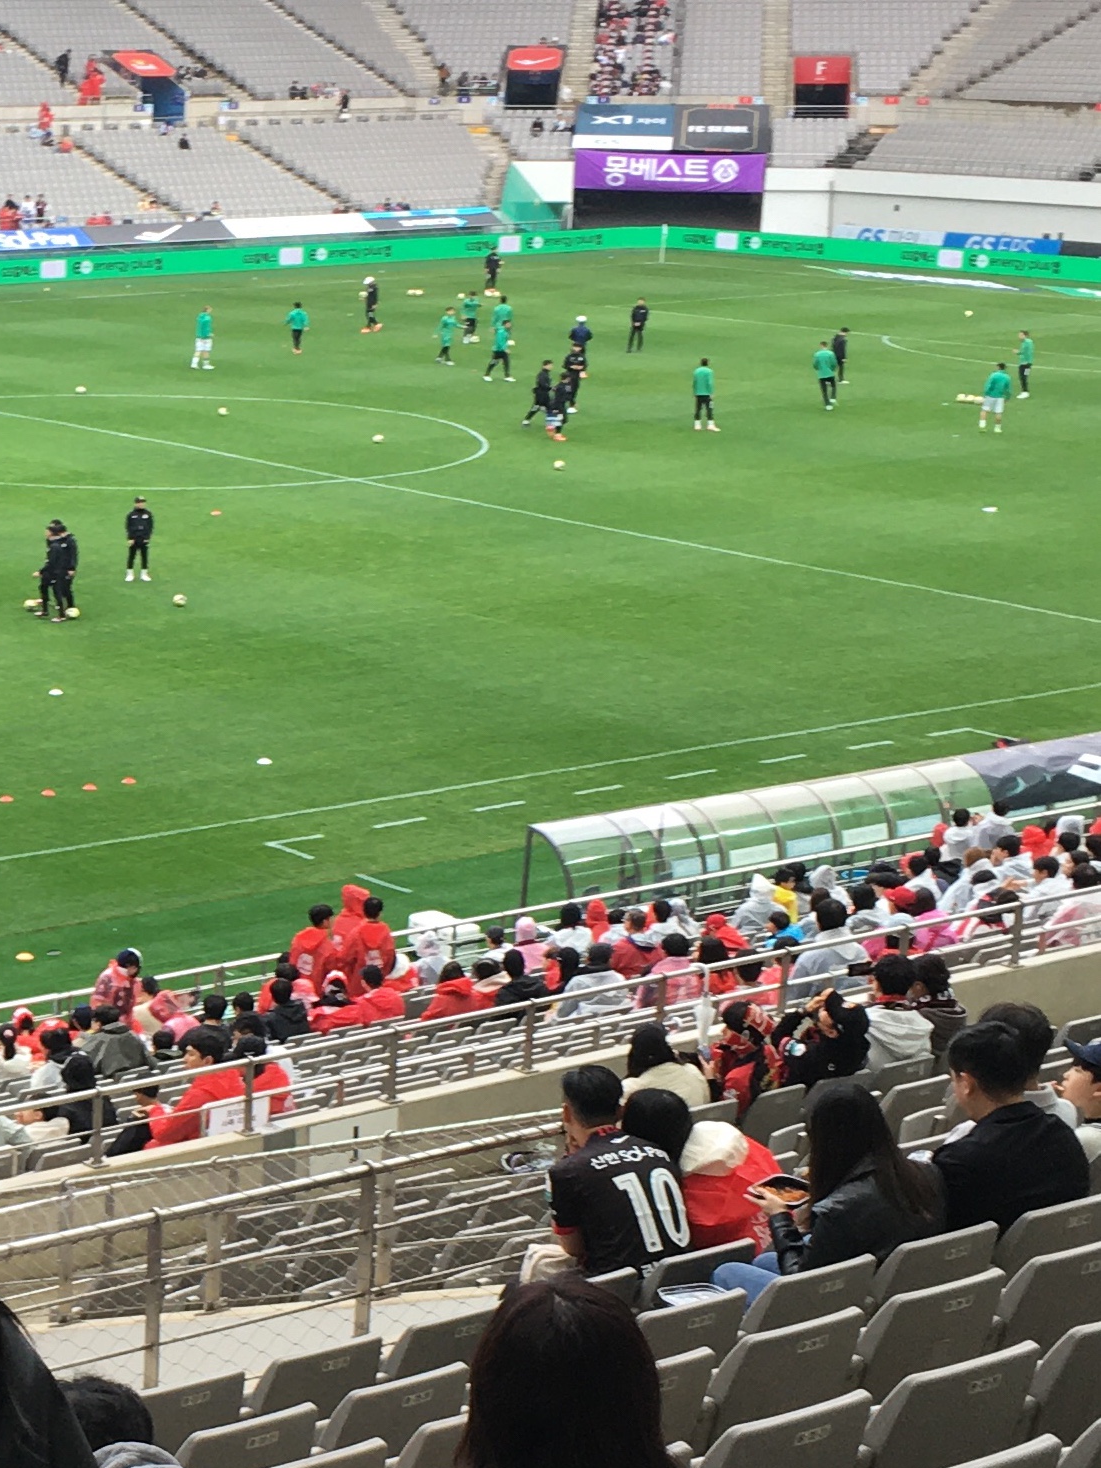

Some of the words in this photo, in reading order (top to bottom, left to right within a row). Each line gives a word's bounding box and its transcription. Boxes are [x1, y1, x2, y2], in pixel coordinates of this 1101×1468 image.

[815, 61, 829, 75] F
[603, 156, 710, 187] 몽베스트
[964, 235, 996, 250] GS
[612, 1167, 691, 1253] 10
